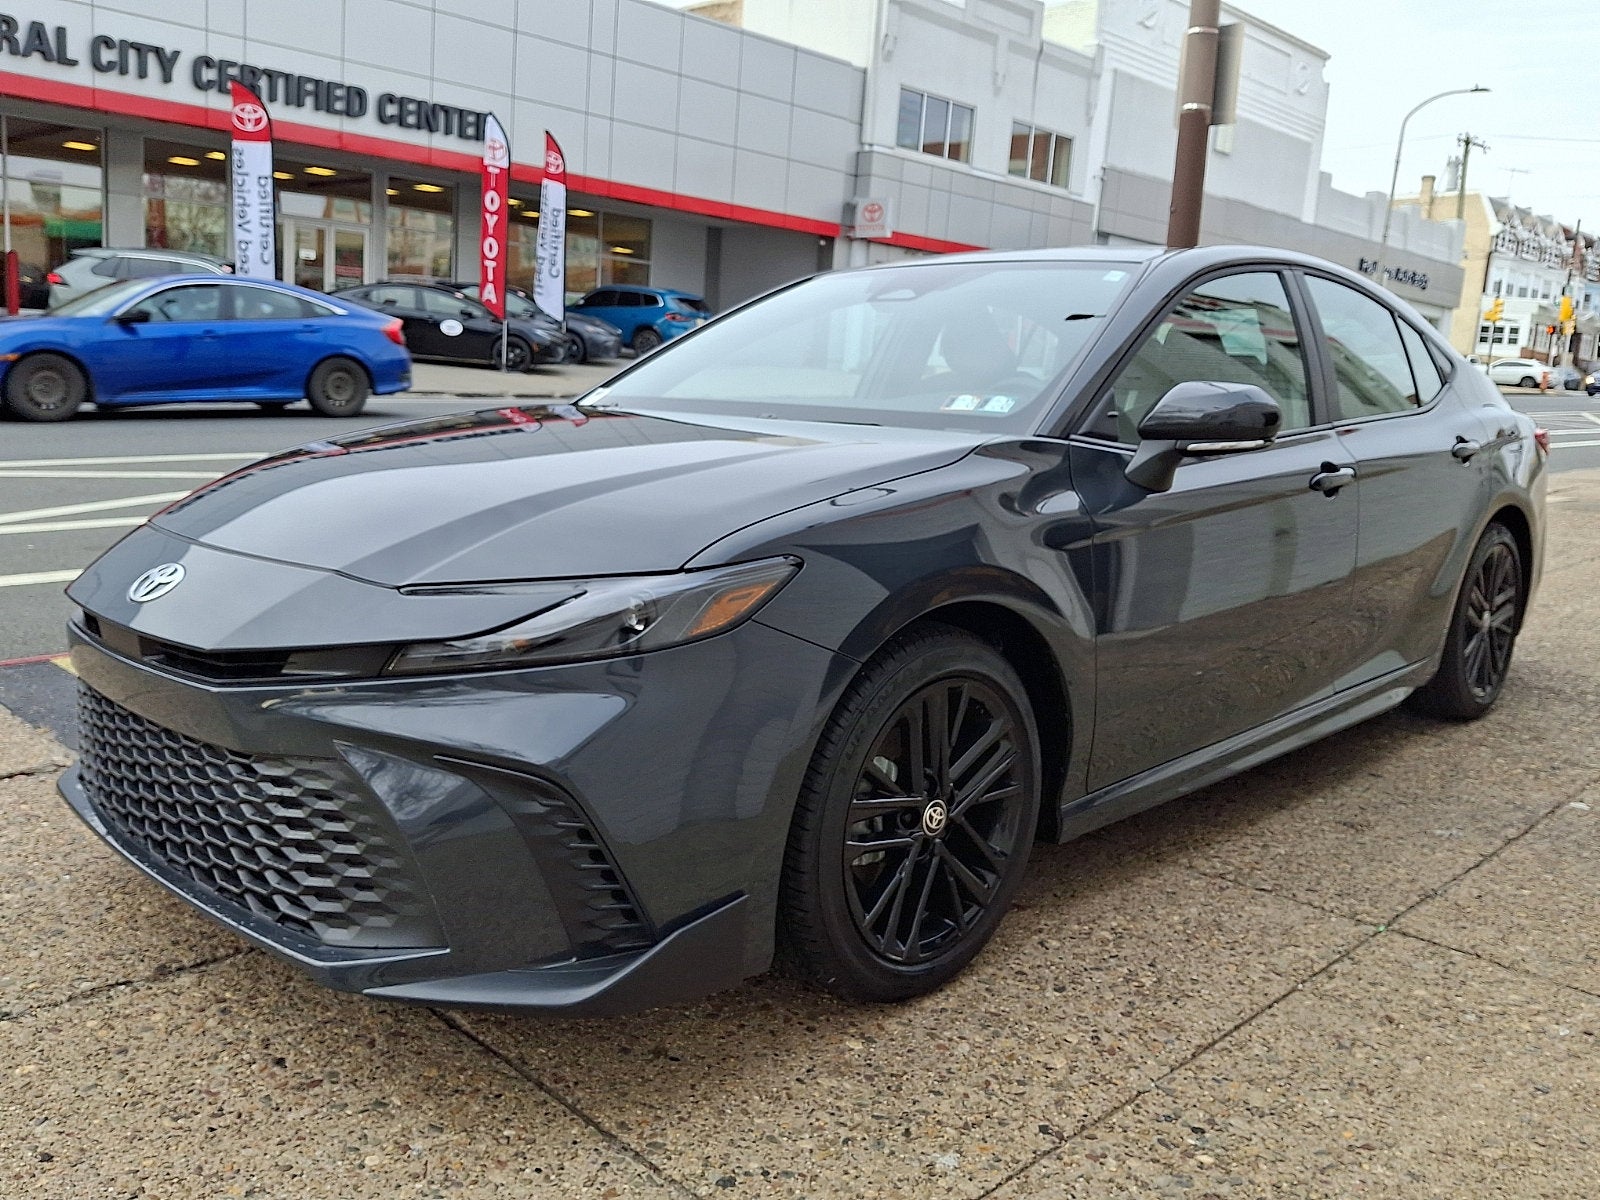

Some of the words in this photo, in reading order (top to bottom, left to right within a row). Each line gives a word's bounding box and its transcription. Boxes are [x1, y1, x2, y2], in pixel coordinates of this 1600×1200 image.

[0, 14, 79, 66] RAL
[91, 35, 181, 84] CITY
[192, 55, 368, 118] CERTIFIED
[483, 165, 500, 304] TOYOTA
